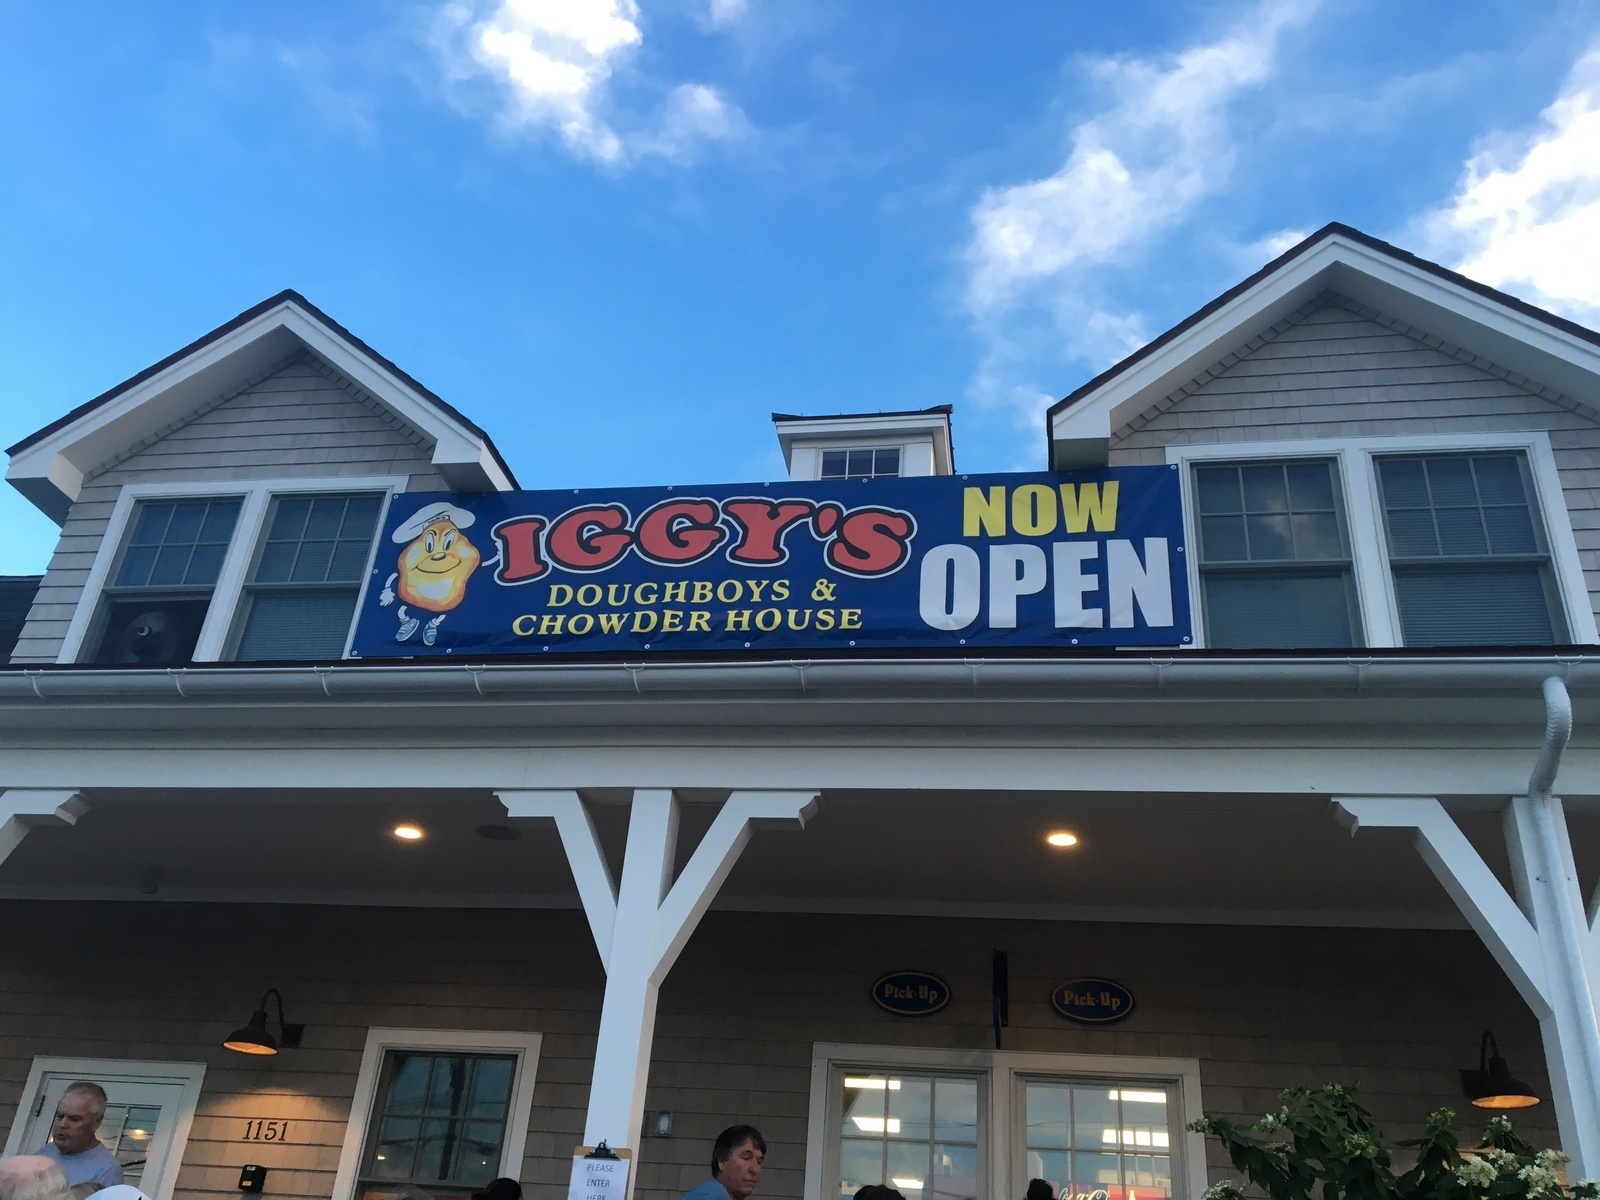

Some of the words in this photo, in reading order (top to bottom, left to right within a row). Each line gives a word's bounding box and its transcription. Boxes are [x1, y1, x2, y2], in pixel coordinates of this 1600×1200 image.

[963, 480, 1119, 537] NOW
[496, 498, 916, 584] IGGY'S
[546, 579, 791, 607] DOUGHBOYS
[810, 578, 837, 601] &
[919, 537, 1174, 631] OPEN
[512, 609, 711, 636] CHOWDER
[725, 608, 863, 632] HOUSE
[242, 1120, 288, 1141] 1151
[586, 1163, 614, 1173] PLEASE
[586, 1178, 611, 1188] ENTER
